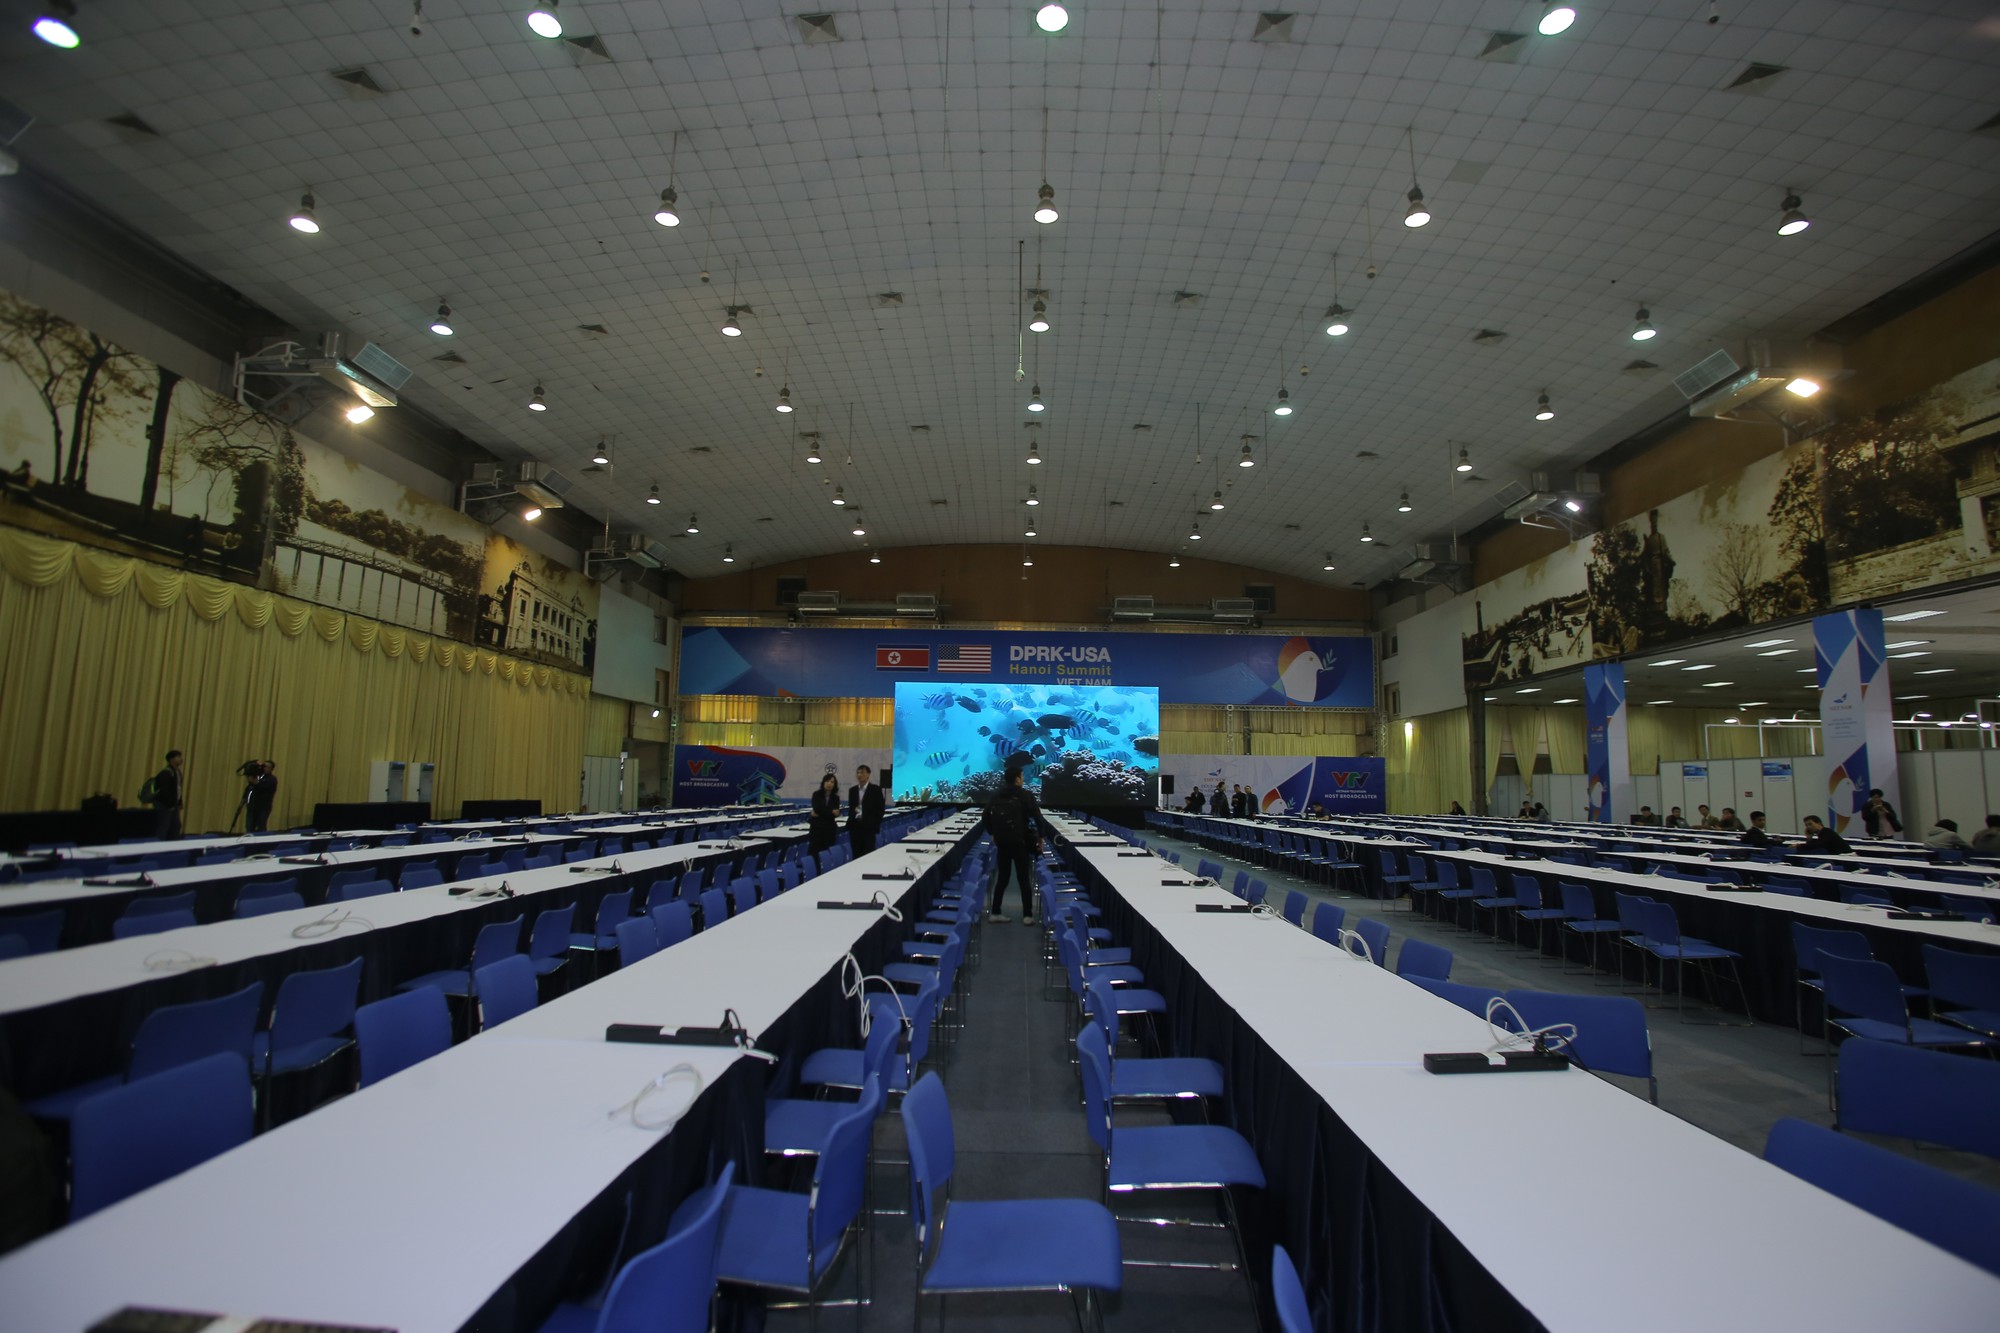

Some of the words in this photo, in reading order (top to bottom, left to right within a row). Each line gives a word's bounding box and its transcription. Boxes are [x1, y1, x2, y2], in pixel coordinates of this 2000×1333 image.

[1010, 646, 1111, 662] DPRK-USA
[1010, 664, 1051, 674] Hanoi
[1057, 665, 1111, 675] Summit
[687, 760, 724, 777] VTV
[1331, 771, 1371, 788] VTV
